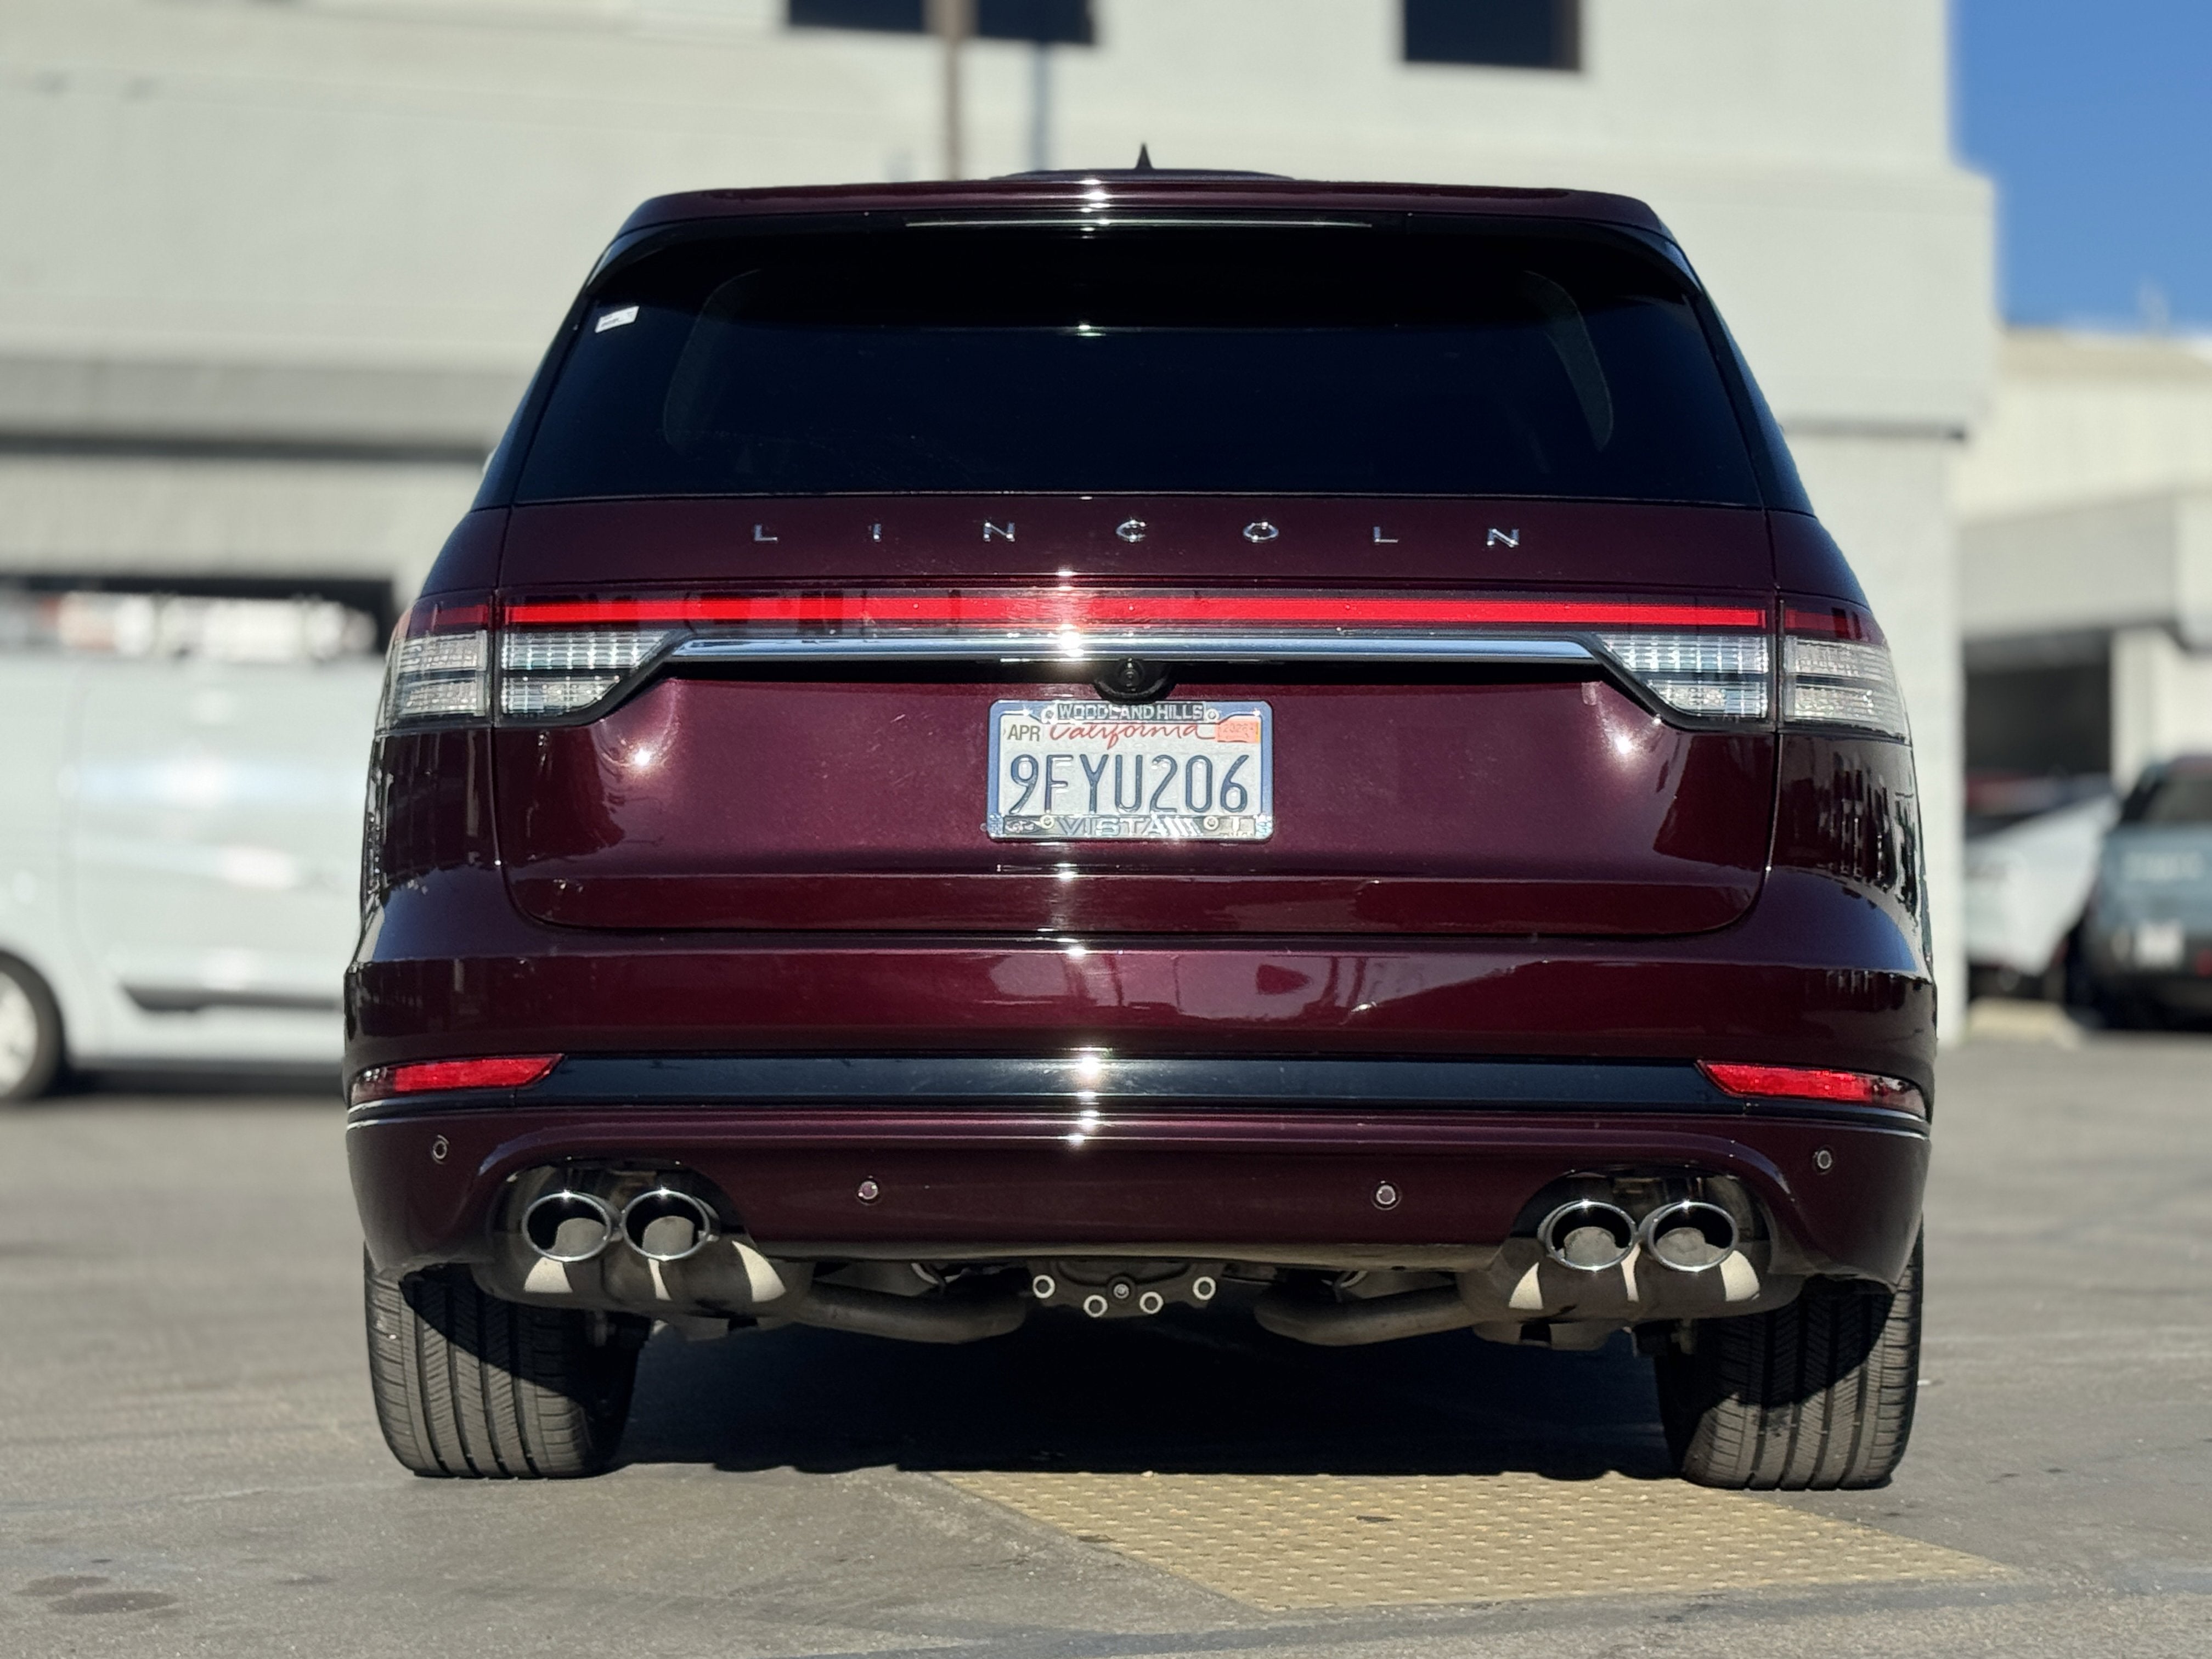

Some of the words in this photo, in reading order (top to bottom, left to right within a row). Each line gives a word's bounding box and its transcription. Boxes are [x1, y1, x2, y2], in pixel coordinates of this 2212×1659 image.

[753, 519, 1520, 548] LINCOLN
[1058, 703, 1156, 720] WOODLAND
[1156, 703, 1203, 720] HILLS
[1007, 724, 1041, 742] APR
[1049, 723, 1216, 750] California
[1008, 754, 1250, 814] 9FYU206
[1057, 816, 1169, 837] VISTA
